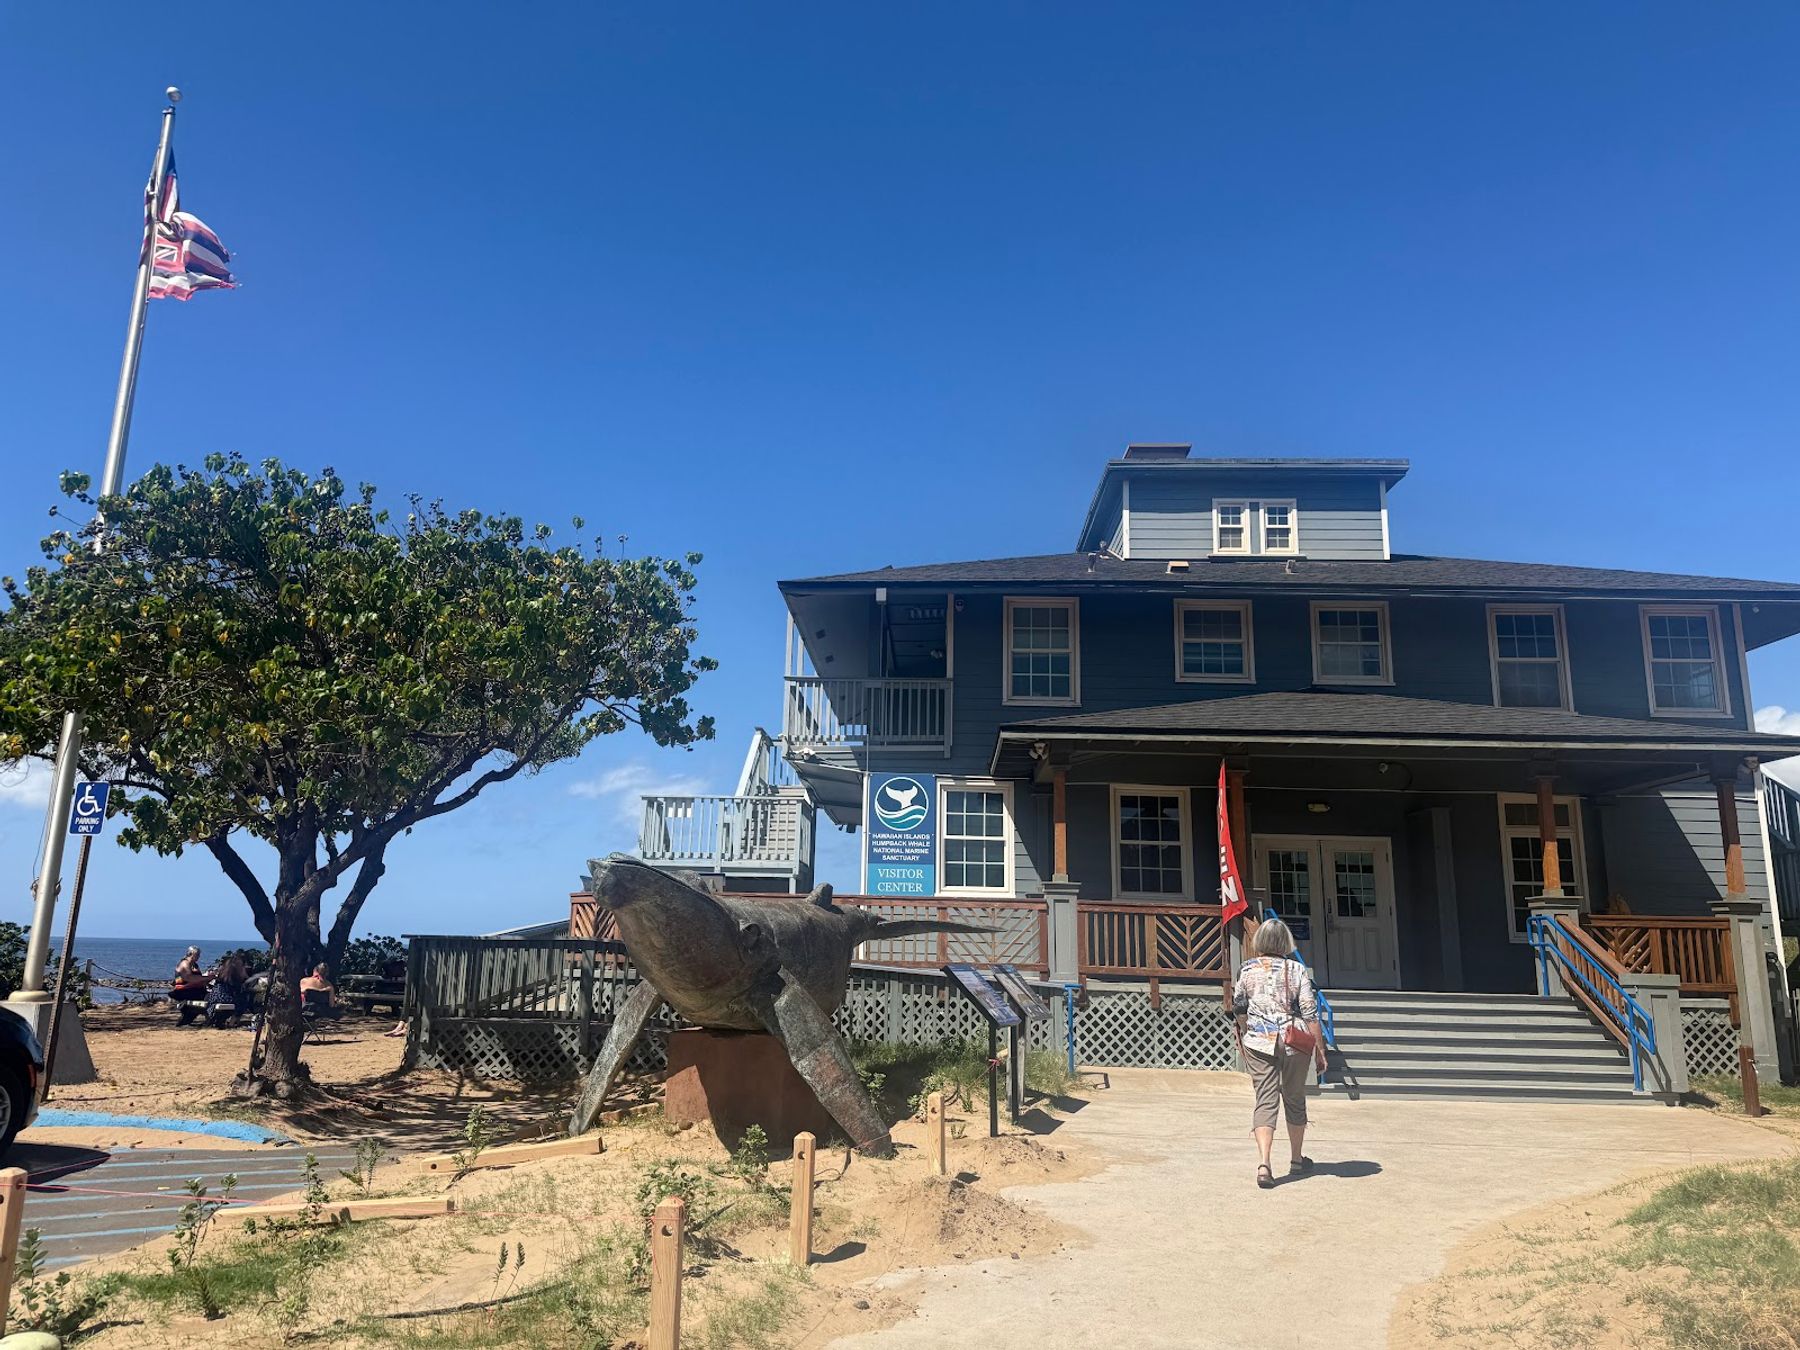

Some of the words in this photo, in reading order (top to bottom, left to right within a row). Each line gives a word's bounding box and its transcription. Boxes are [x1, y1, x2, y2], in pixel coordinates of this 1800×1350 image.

[74, 817, 100, 825] PARKING
[77, 824, 95, 833] ONLY
[877, 868, 925, 879] VISITOR
[877, 881, 924, 893] CENTER
